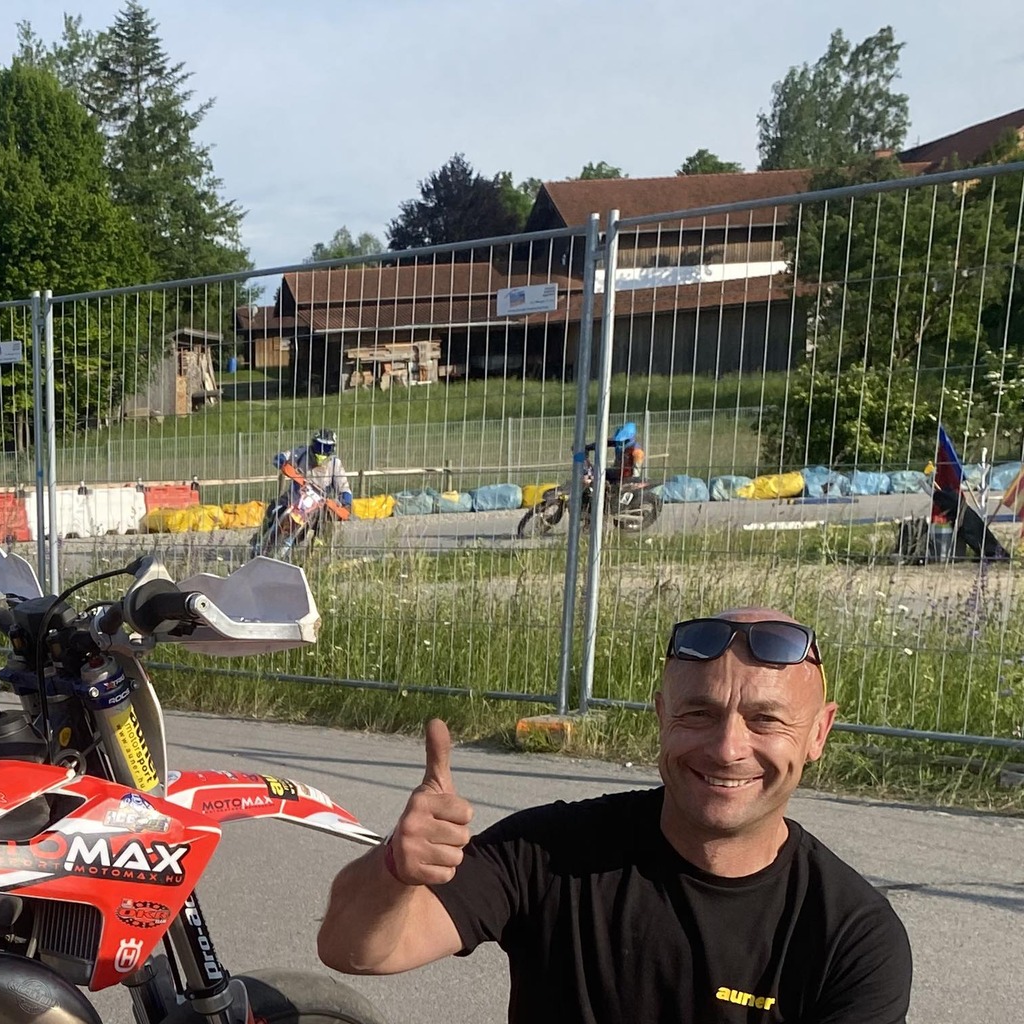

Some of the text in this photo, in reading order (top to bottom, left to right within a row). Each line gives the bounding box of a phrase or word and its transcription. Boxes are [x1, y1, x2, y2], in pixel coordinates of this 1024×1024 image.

[124, 722, 152, 783] motorsport
[202, 795, 274, 812] MOTOMAX
[118, 908, 170, 920] OKR
[716, 986, 776, 1011] auner
